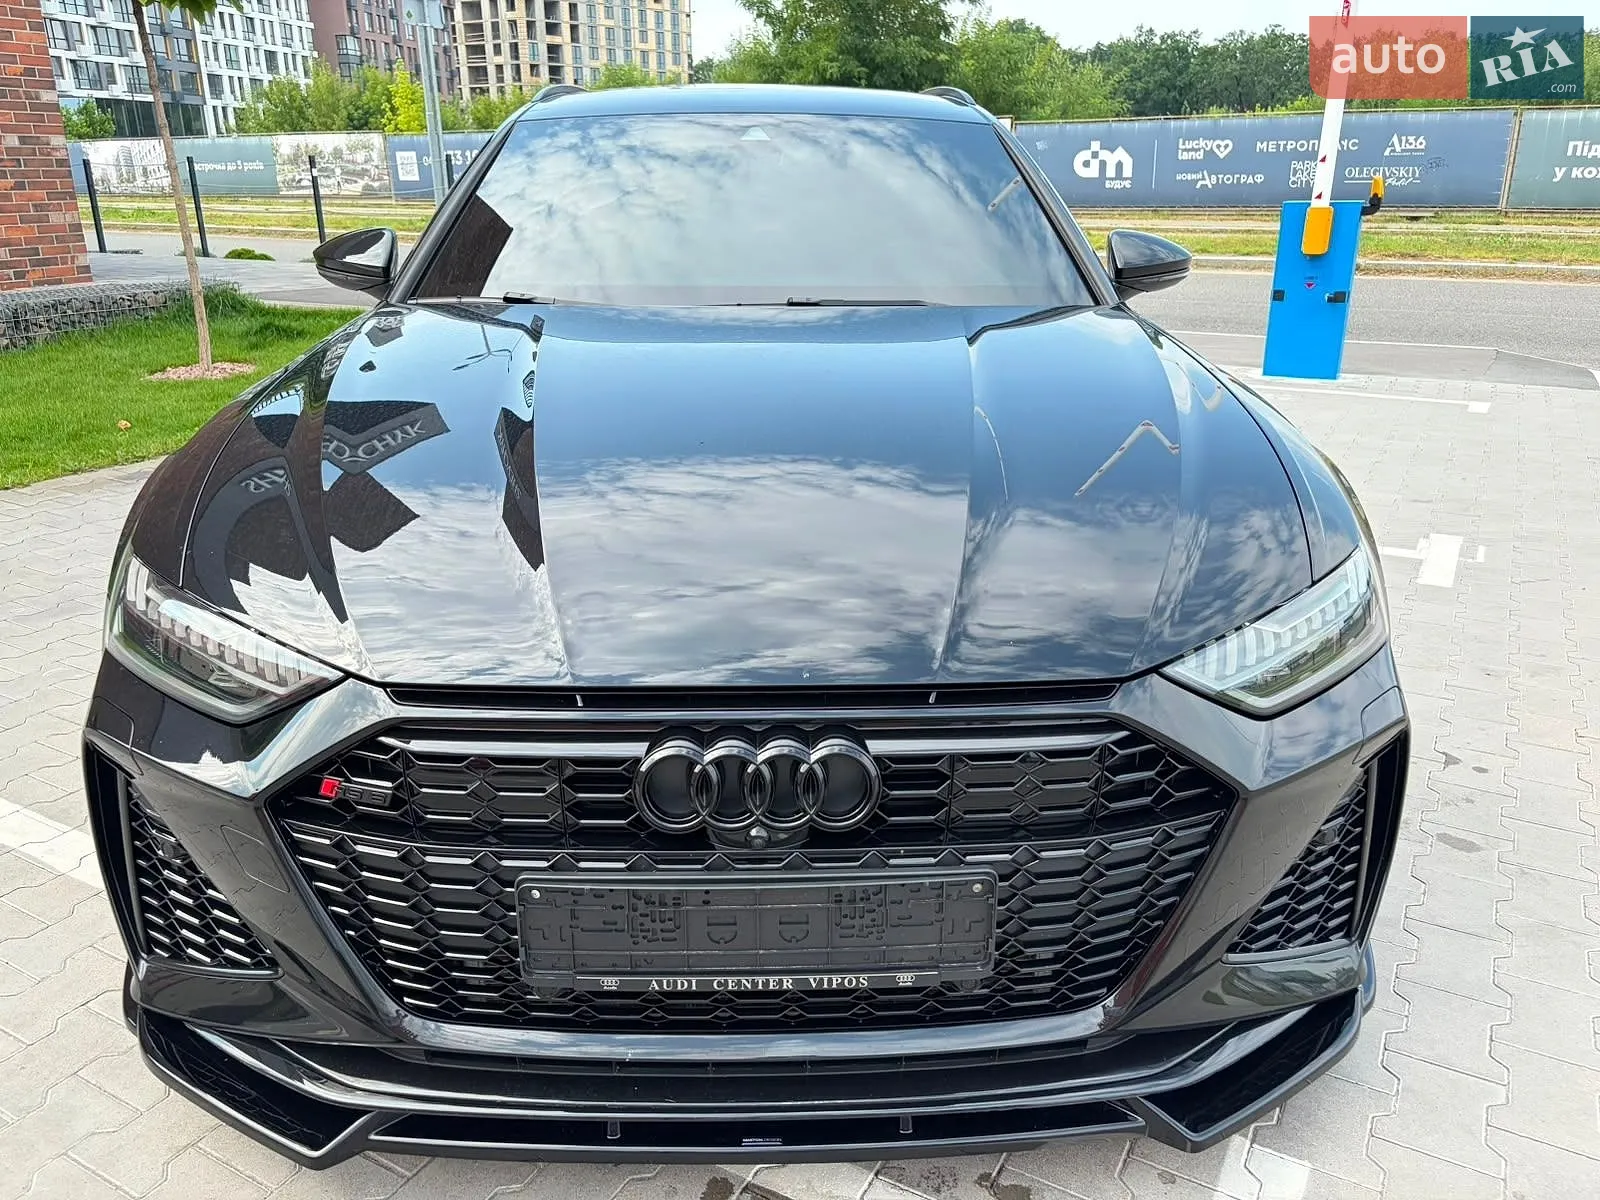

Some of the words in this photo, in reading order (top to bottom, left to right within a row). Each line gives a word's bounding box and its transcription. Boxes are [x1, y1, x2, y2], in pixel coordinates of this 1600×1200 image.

[1178, 137, 1213, 151] Lucky
[1178, 149, 1204, 160] land
[648, 979, 697, 991] AUDI
[712, 977, 794, 991] CENTER
[808, 975, 868, 989] VIPOS
